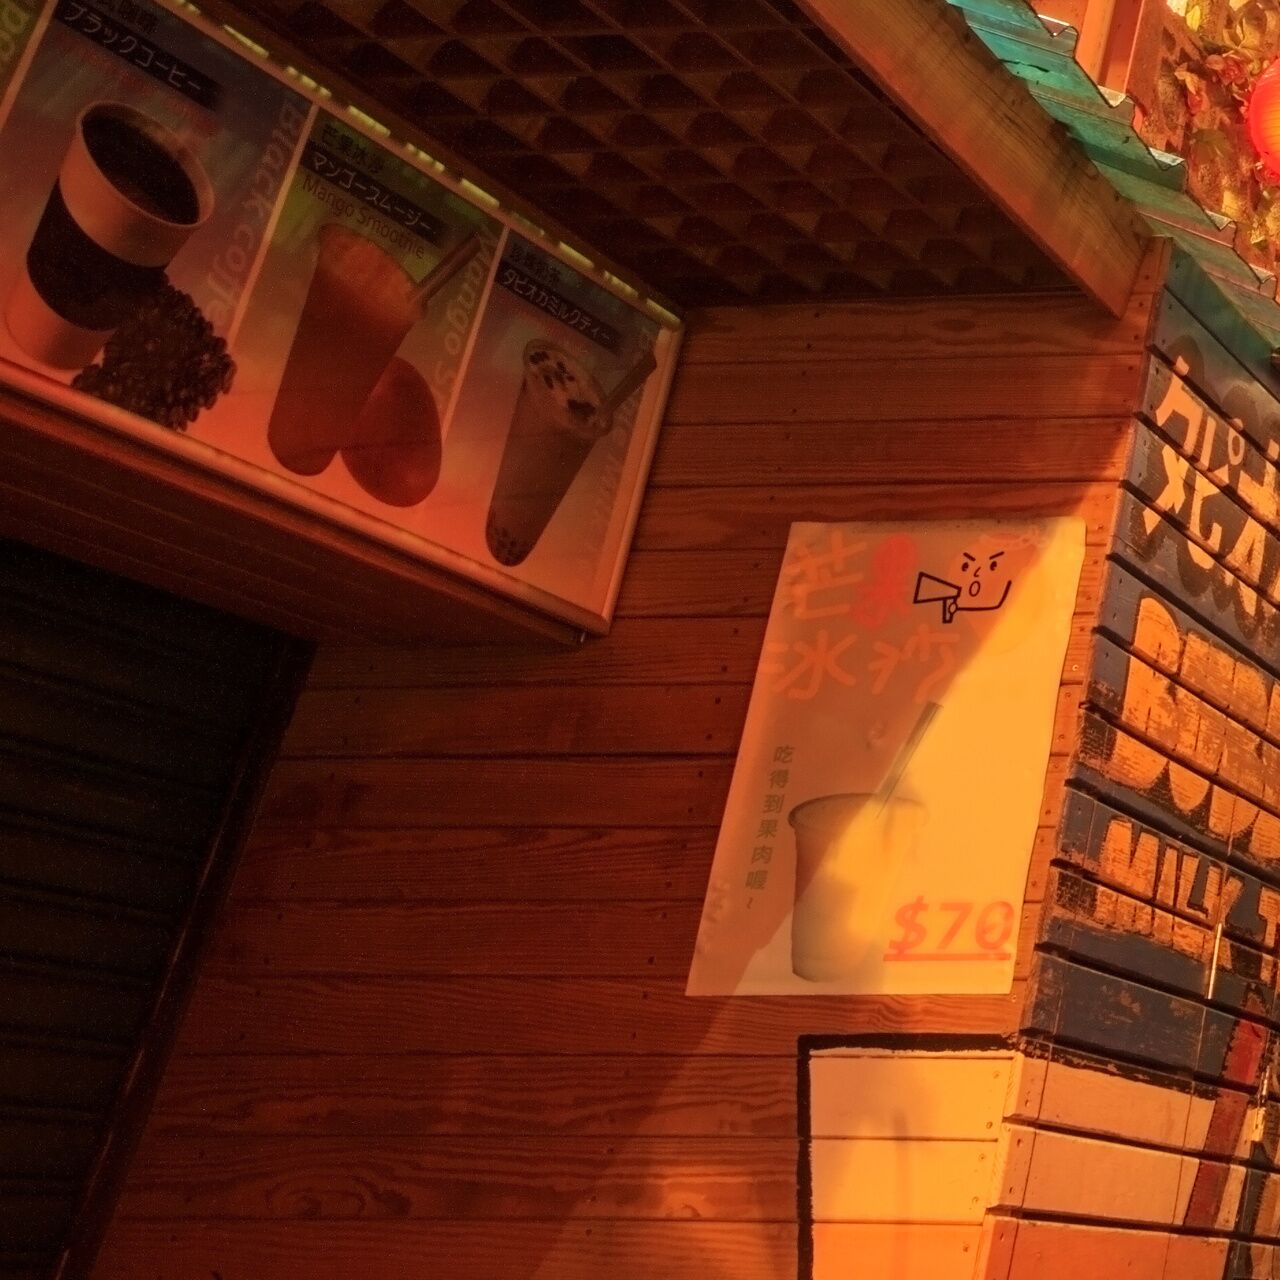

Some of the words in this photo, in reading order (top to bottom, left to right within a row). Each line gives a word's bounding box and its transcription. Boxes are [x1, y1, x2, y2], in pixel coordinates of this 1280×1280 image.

[63, 0, 202, 92] ブラックコーヒー
[302, 173, 358, 218] Mango
[356, 206, 426, 260] Smoothie
[312, 150, 434, 231] マンゴースムージー
[887, 894, 1016, 956] $70
[1094, 816, 1247, 971] MILK
